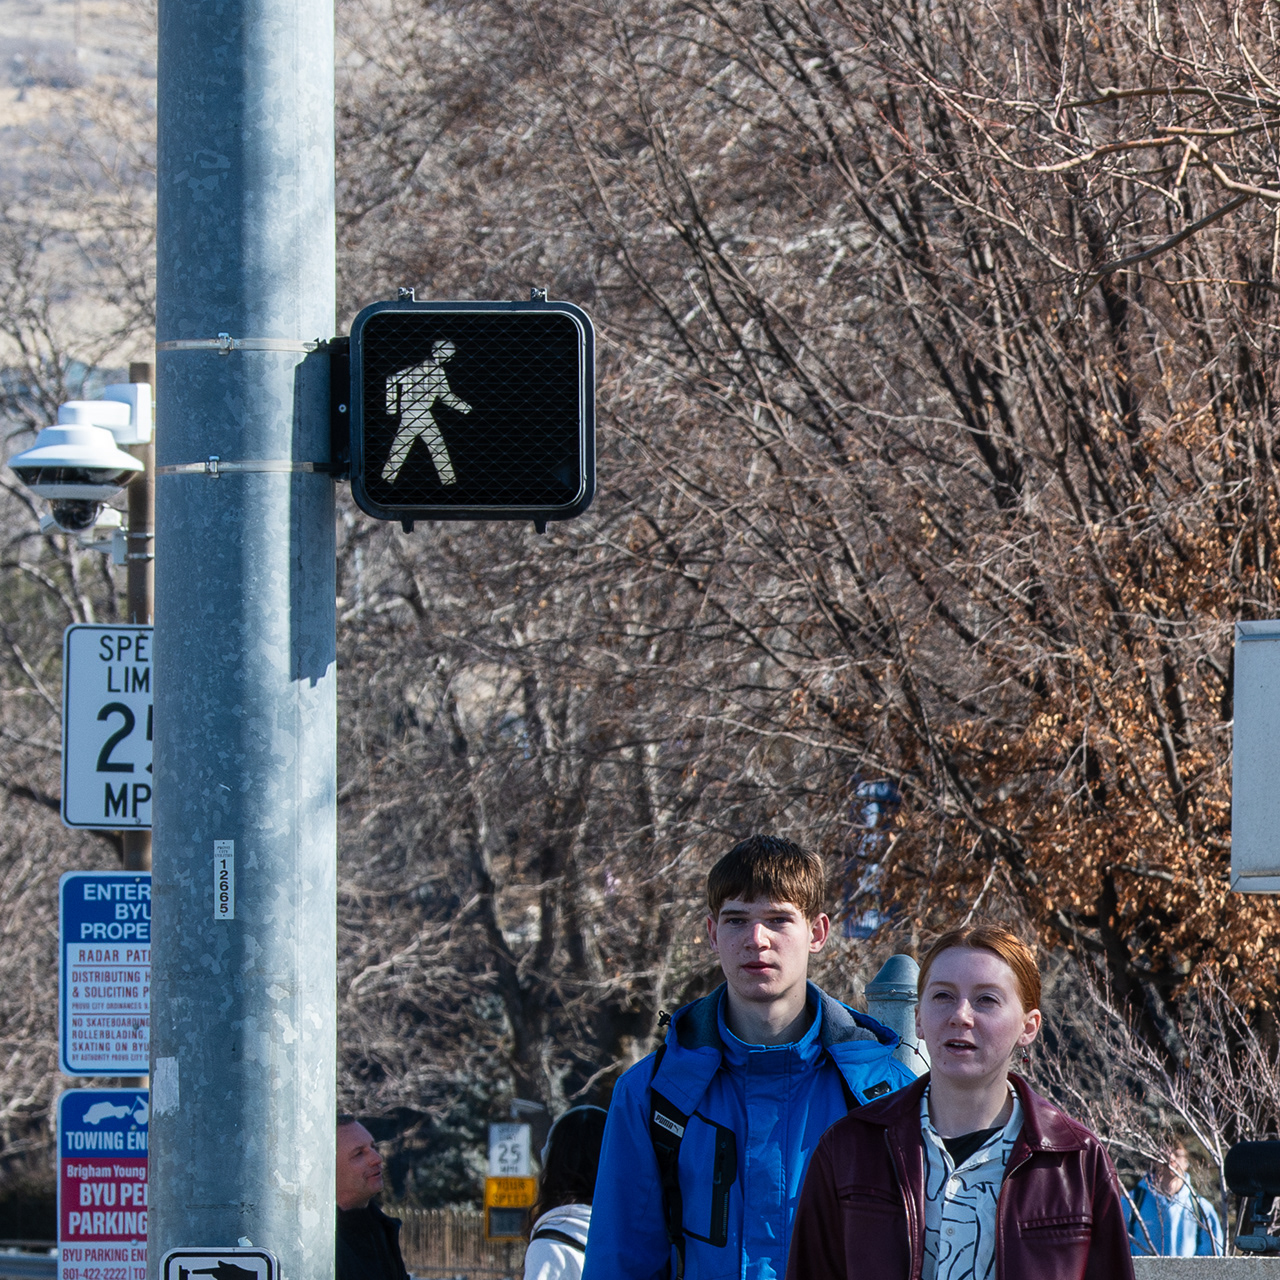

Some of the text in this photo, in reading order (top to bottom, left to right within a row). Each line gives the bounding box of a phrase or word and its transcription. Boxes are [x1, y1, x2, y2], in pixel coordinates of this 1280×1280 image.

[99, 635, 149, 662] SPE
[107, 666, 150, 693] LIM
[96, 702, 153, 774] 2
[104, 782, 152, 818] MP
[84, 884, 151, 900] ENTER
[80, 922, 149, 939] PROPE
[78, 949, 119, 962] RADAR
[72, 971, 140, 983] DISTRIBUTING
[72, 986, 79, 998] &
[84, 986, 138, 998] SOLICITING
[72, 1017, 83, 1027] NO
[72, 1042, 110, 1052] SKATING
[115, 1042, 128, 1052] ON
[66, 1131, 149, 1150] TOWING EN
[66, 1164, 146, 1180] Brigham Young
[79, 1183, 116, 1206] BYU
[69, 1212, 148, 1235] PARKING
[62, 1249, 147, 1262] BYU PARKING EN
[62, 1268, 127, 1280] 801-422-2222
